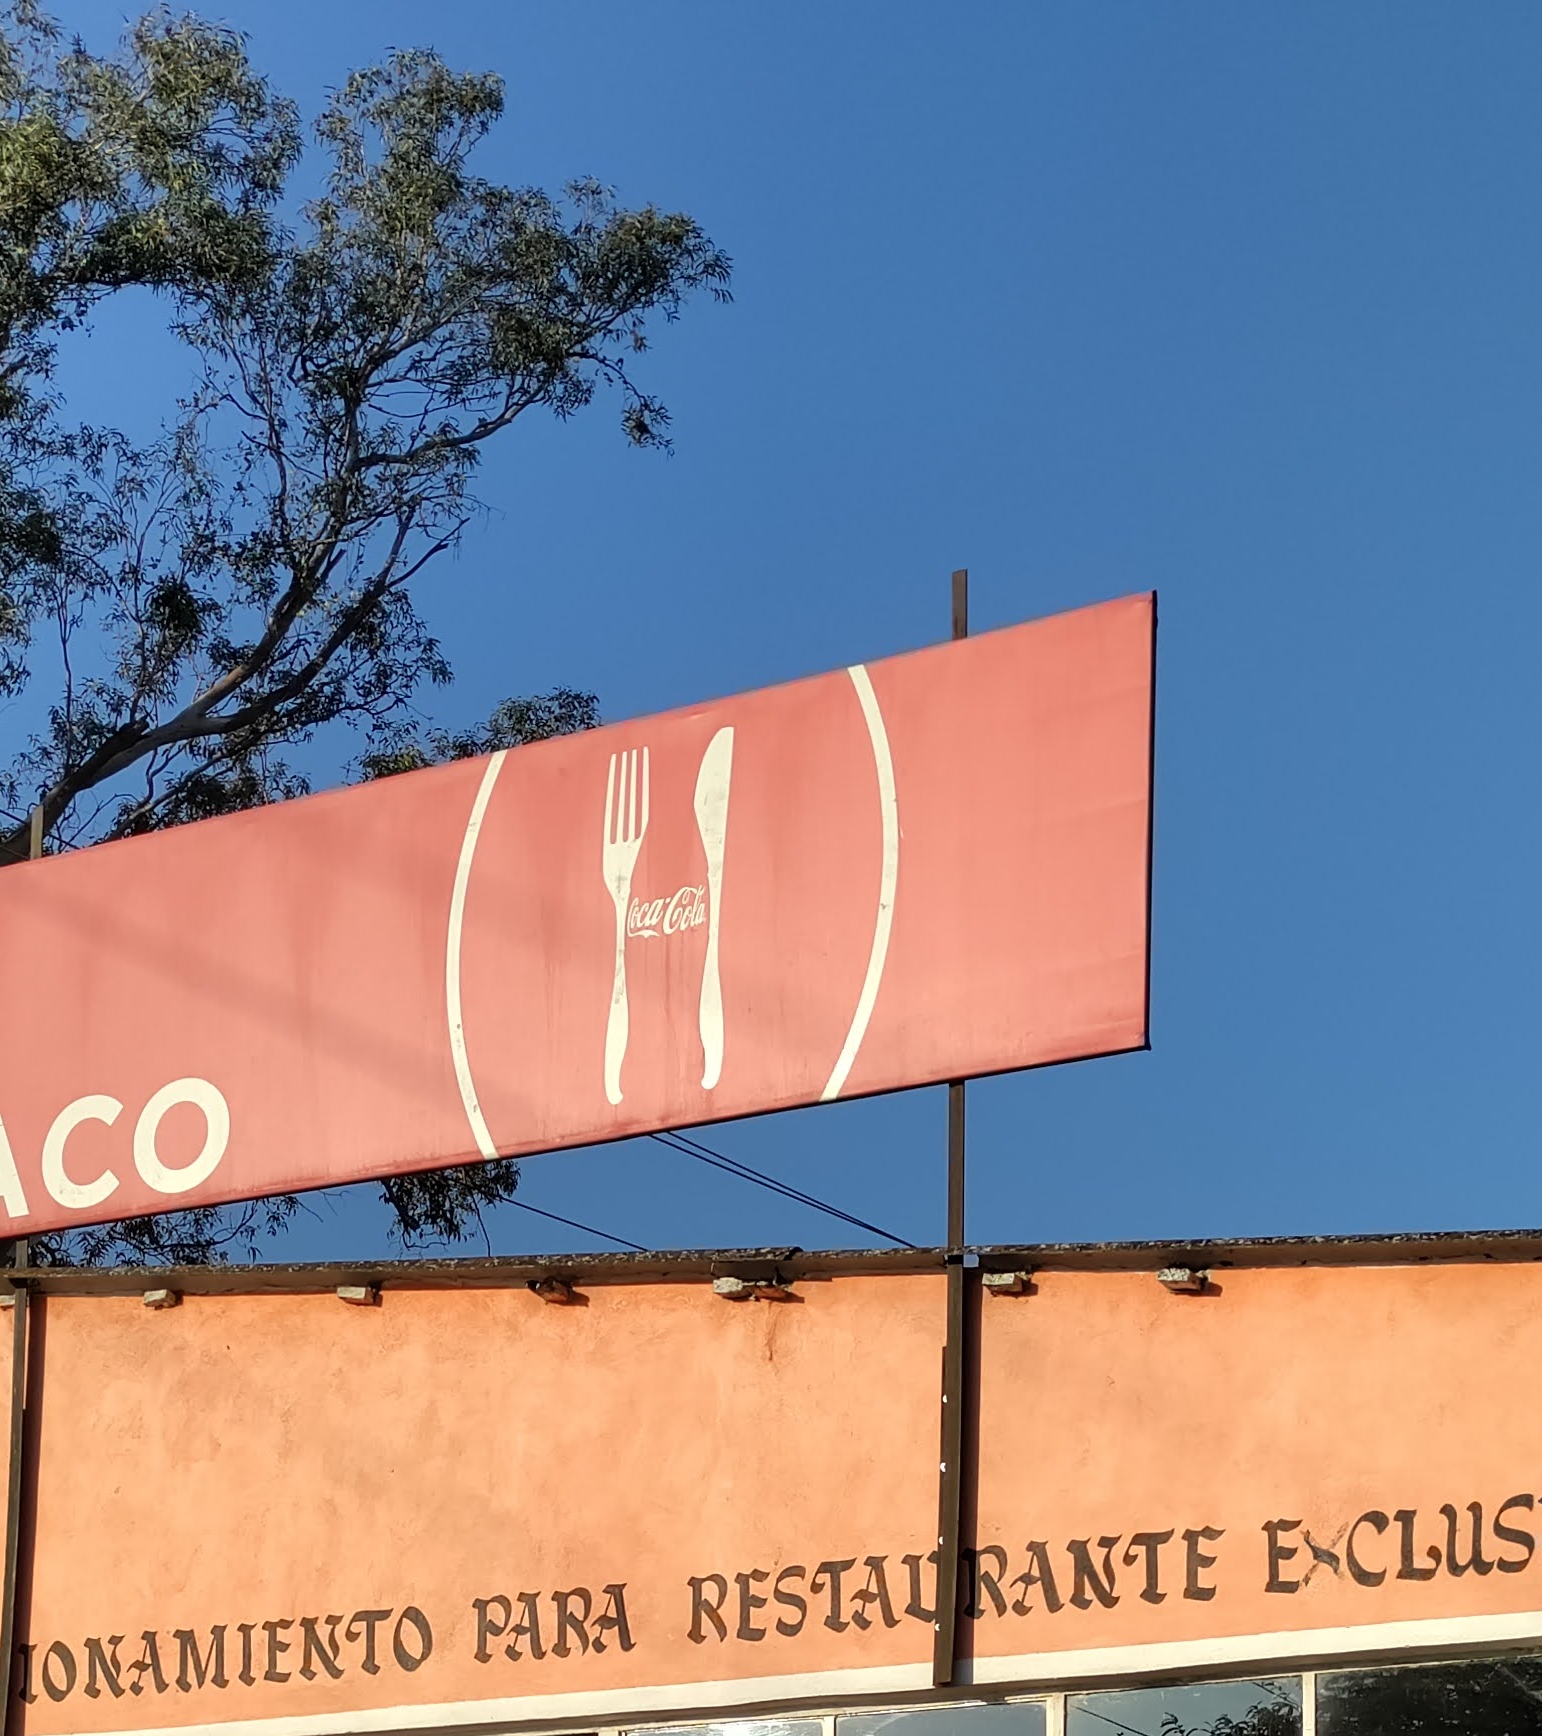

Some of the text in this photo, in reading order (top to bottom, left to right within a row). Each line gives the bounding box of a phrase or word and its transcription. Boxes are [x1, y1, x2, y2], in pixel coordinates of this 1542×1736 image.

[627, 884, 706, 939] Coca-Cola
[472, 1582, 637, 1664] PARA
[686, 1525, 1227, 1644] RESTAURANTE
